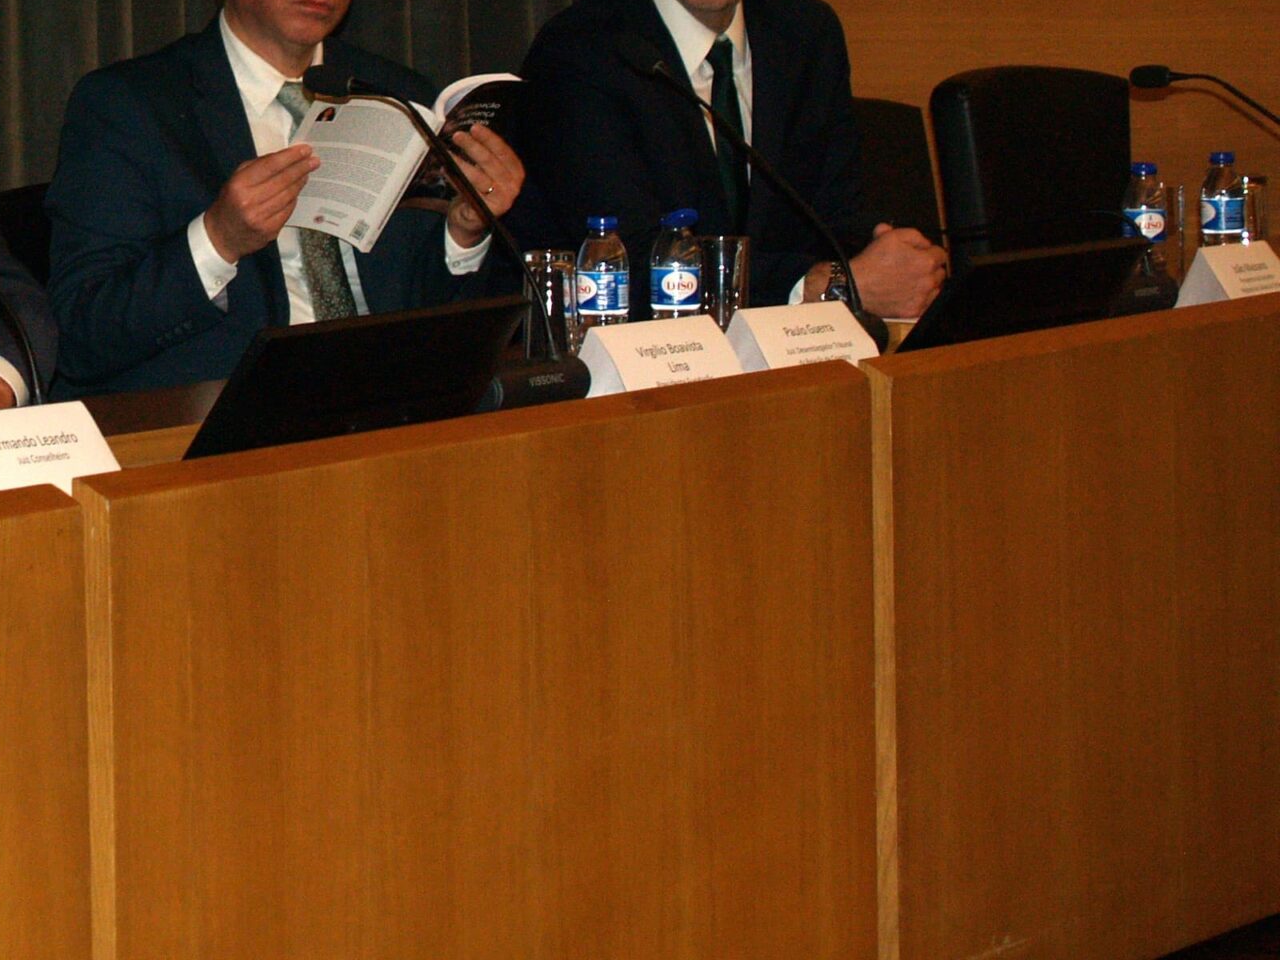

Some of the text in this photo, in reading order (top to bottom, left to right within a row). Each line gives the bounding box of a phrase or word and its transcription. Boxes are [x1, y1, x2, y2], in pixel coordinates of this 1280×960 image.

[782, 324, 835, 338] Paulo Guerra
[665, 341, 704, 355] Boavista
[667, 360, 690, 374] Lima
[35, 431, 79, 447] Leandro
